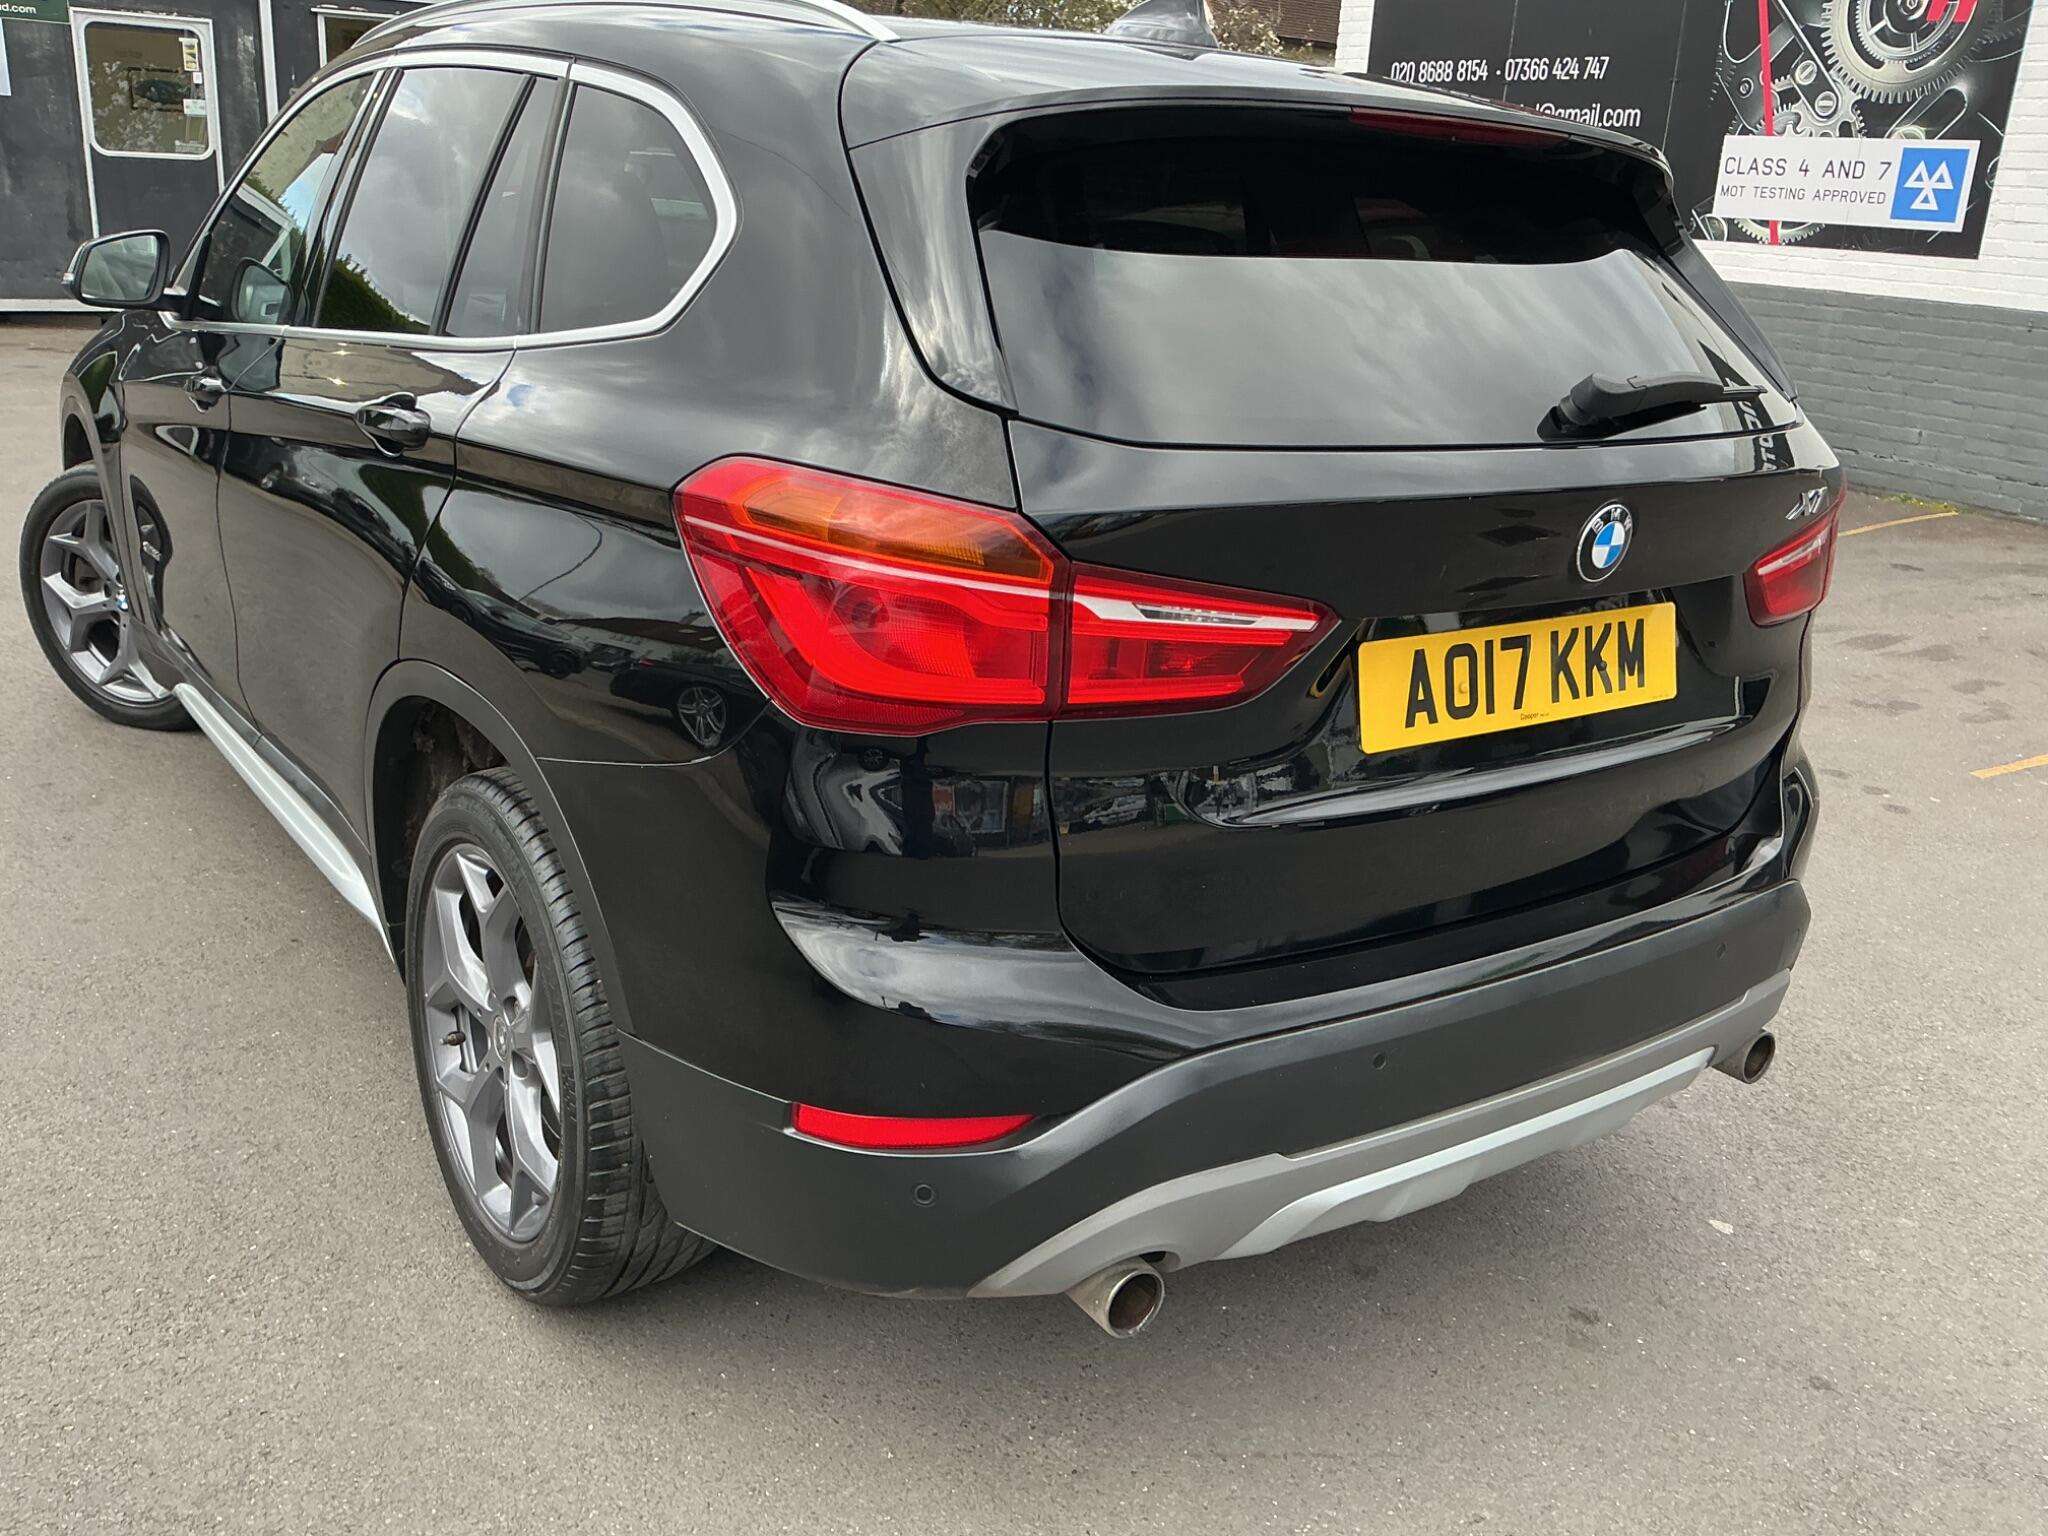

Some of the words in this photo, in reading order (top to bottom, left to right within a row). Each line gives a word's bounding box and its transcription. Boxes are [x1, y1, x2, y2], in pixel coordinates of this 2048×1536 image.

[0, 3, 37, 14] d.com
[1391, 61, 1416, 83] 020
[1418, 60, 1453, 82] 8688
[1456, 59, 1488, 81] 8154
[1505, 57, 1549, 81] 07366
[1552, 57, 1579, 80] 424
[1583, 56, 1609, 80] 747
[1724, 156, 1787, 176] CLASS
[1798, 158, 1810, 177] 4
[1822, 159, 1866, 179] AND
[1878, 161, 1893, 180] 7
[1720, 185, 1746, 197] MOT
[1753, 186, 1806, 200] TESTING
[1812, 189, 1886, 204] APPROVED
[1592, 507, 1633, 534] BMW
[1405, 634, 1532, 728] AO17
[1550, 618, 1645, 704] KKM
